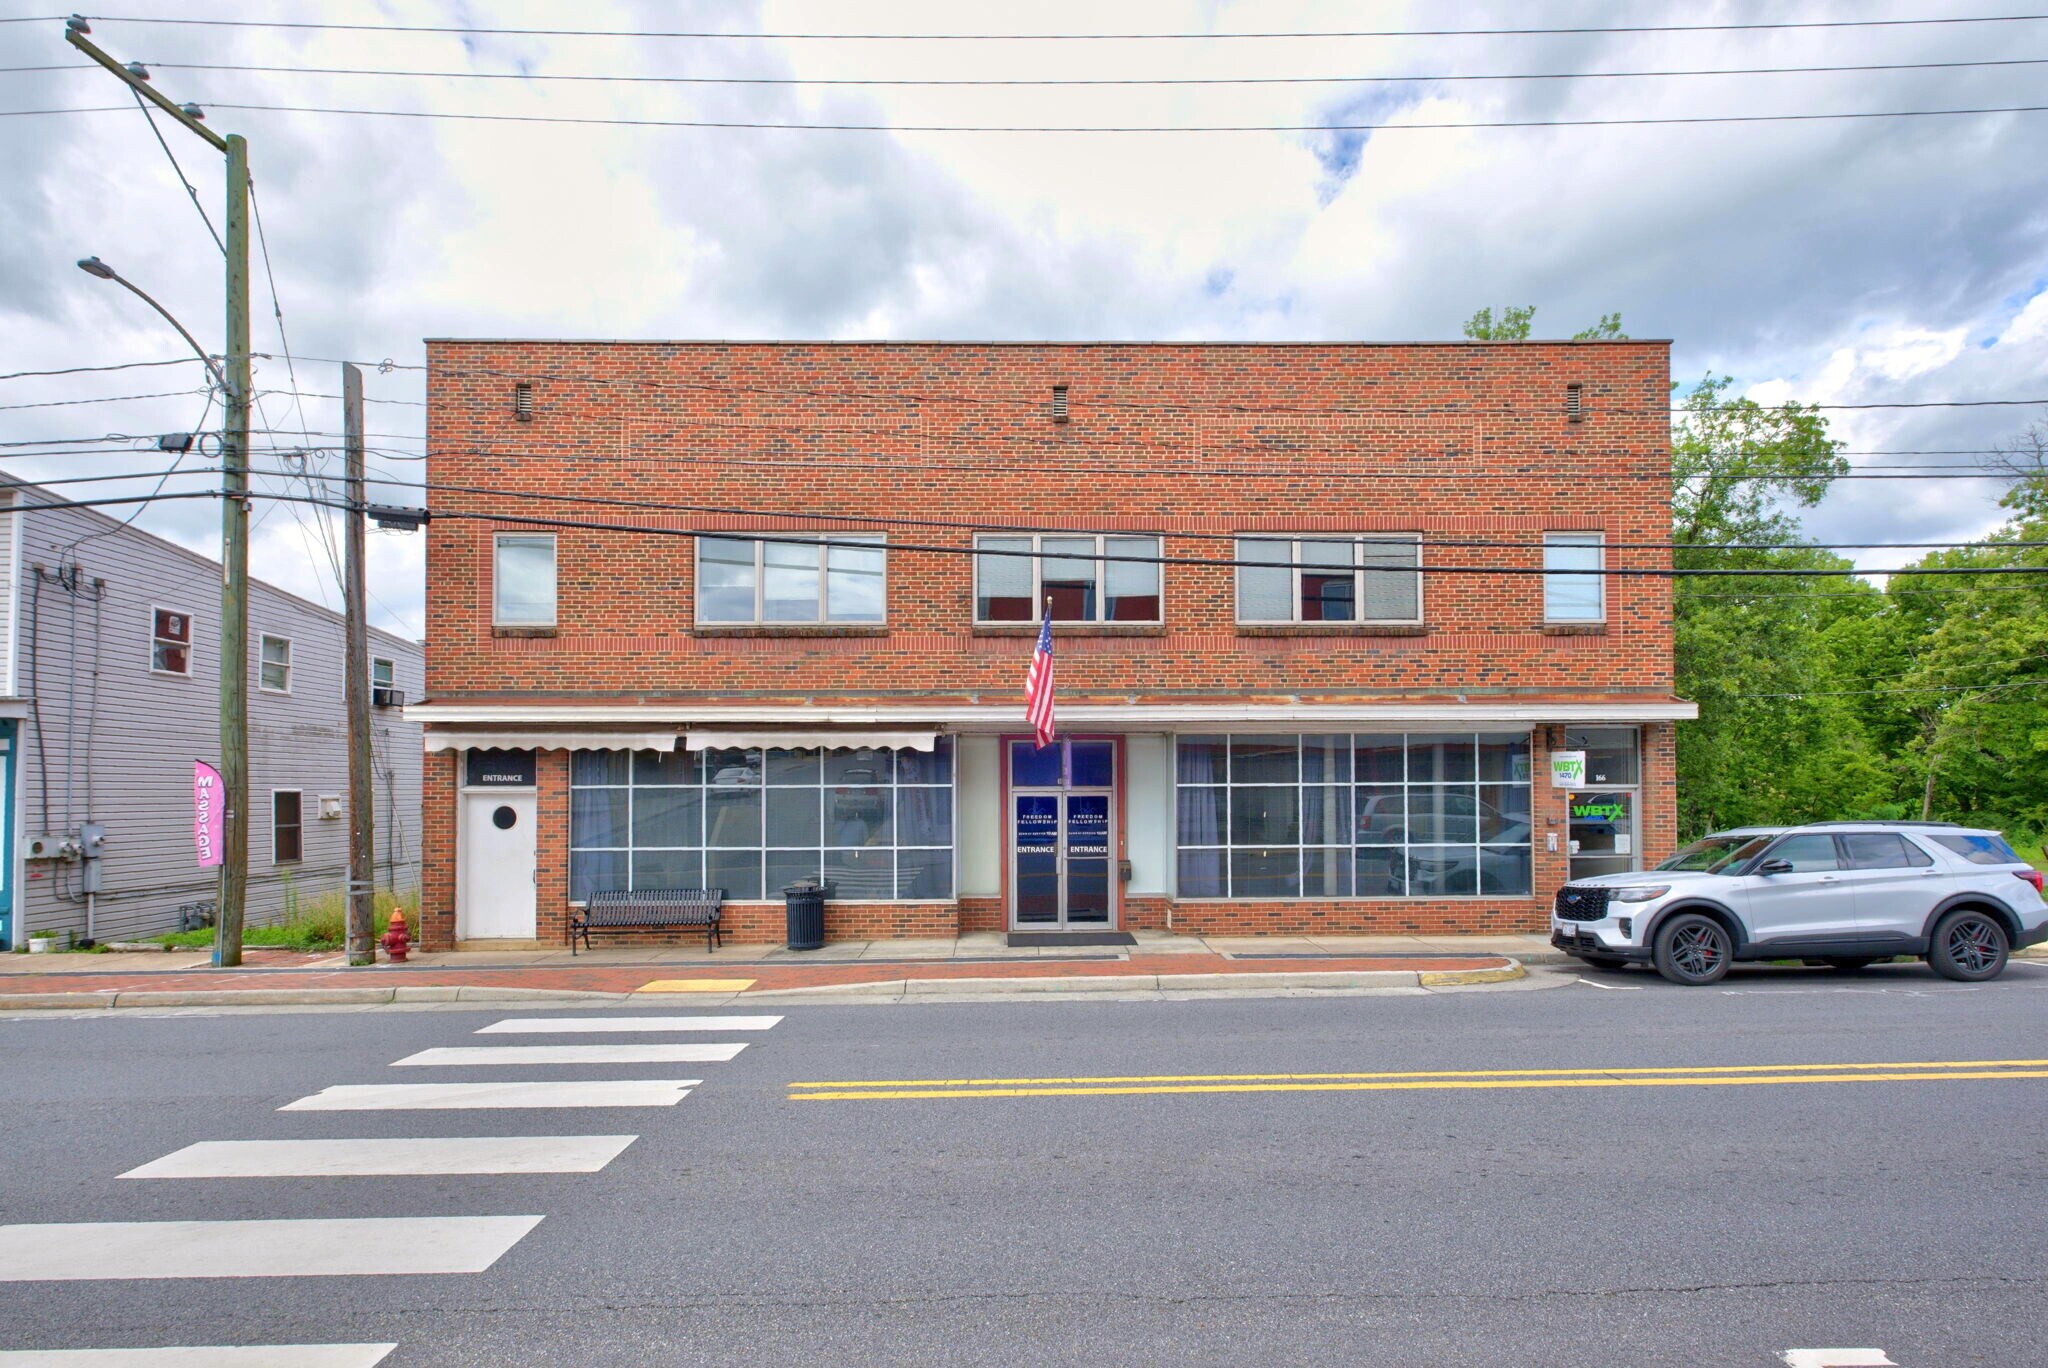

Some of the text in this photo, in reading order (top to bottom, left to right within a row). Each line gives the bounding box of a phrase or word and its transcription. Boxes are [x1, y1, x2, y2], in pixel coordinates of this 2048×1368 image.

[1553, 760, 1583, 780] WBTX
[482, 774, 523, 782] ENTRANCE
[1595, 774, 1606, 782] 166
[1573, 804, 1623, 822] WBTX
